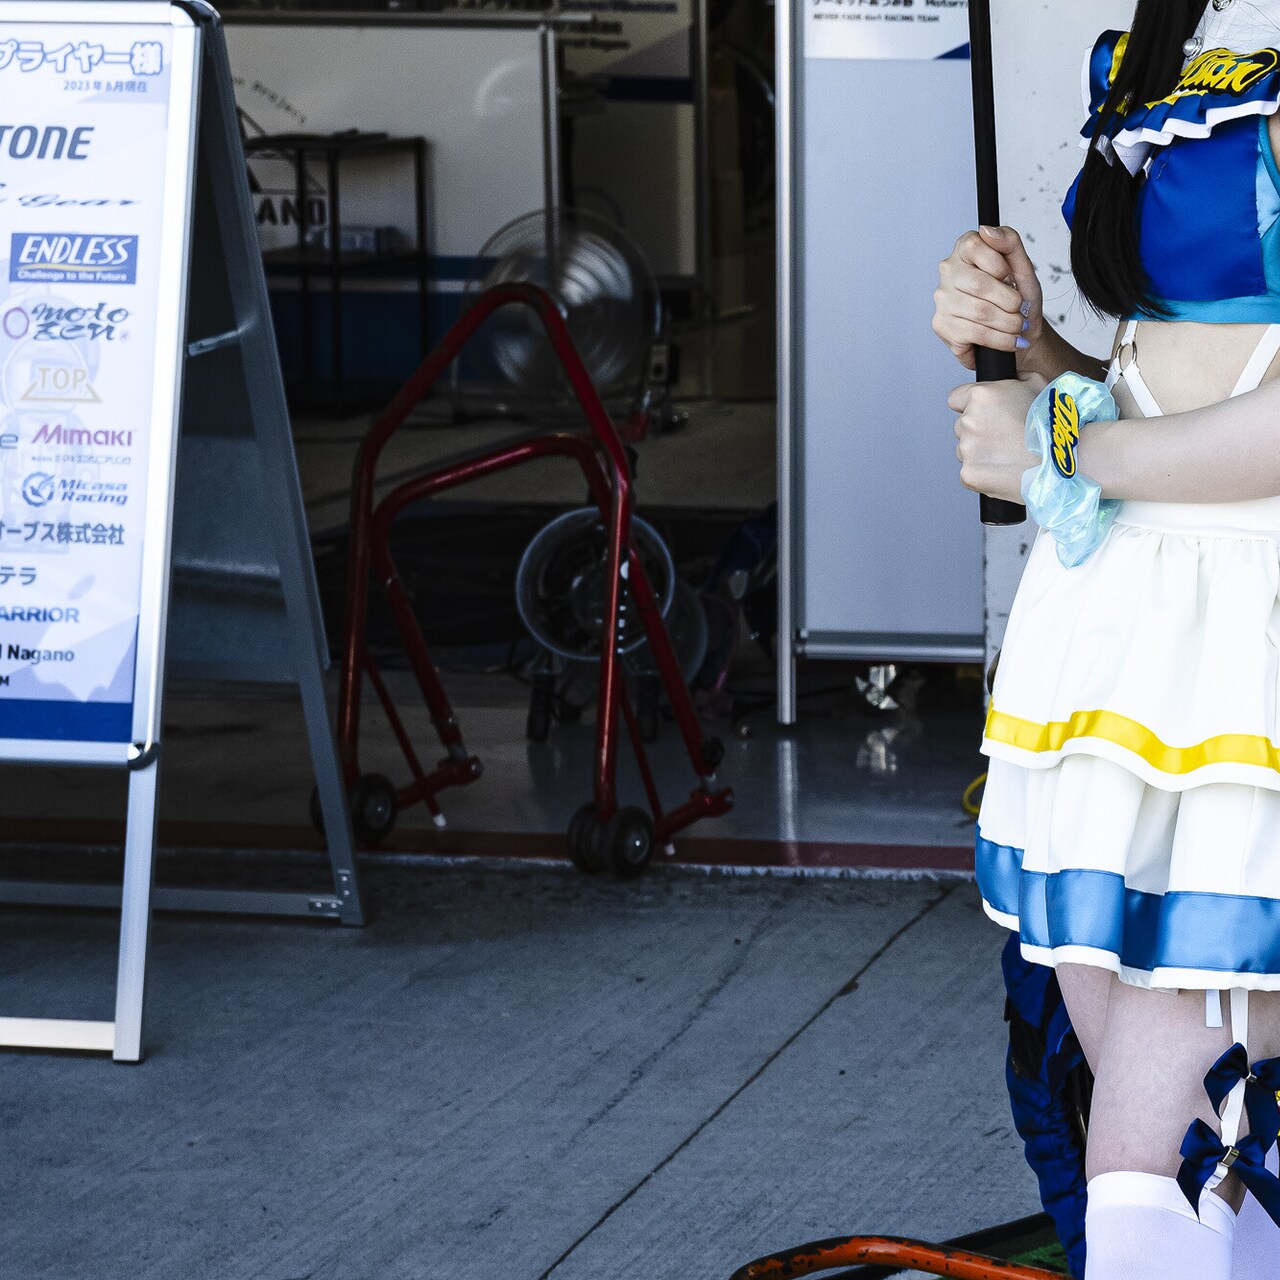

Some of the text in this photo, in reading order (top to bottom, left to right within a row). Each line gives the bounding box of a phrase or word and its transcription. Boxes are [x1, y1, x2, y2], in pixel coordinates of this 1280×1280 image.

[19, 236, 132, 265] ENDLESS
[38, 368, 87, 389] TOP
[31, 424, 132, 446] Mimaki
[61, 492, 128, 506] Racing
[7, 644, 75, 665] Nagano
